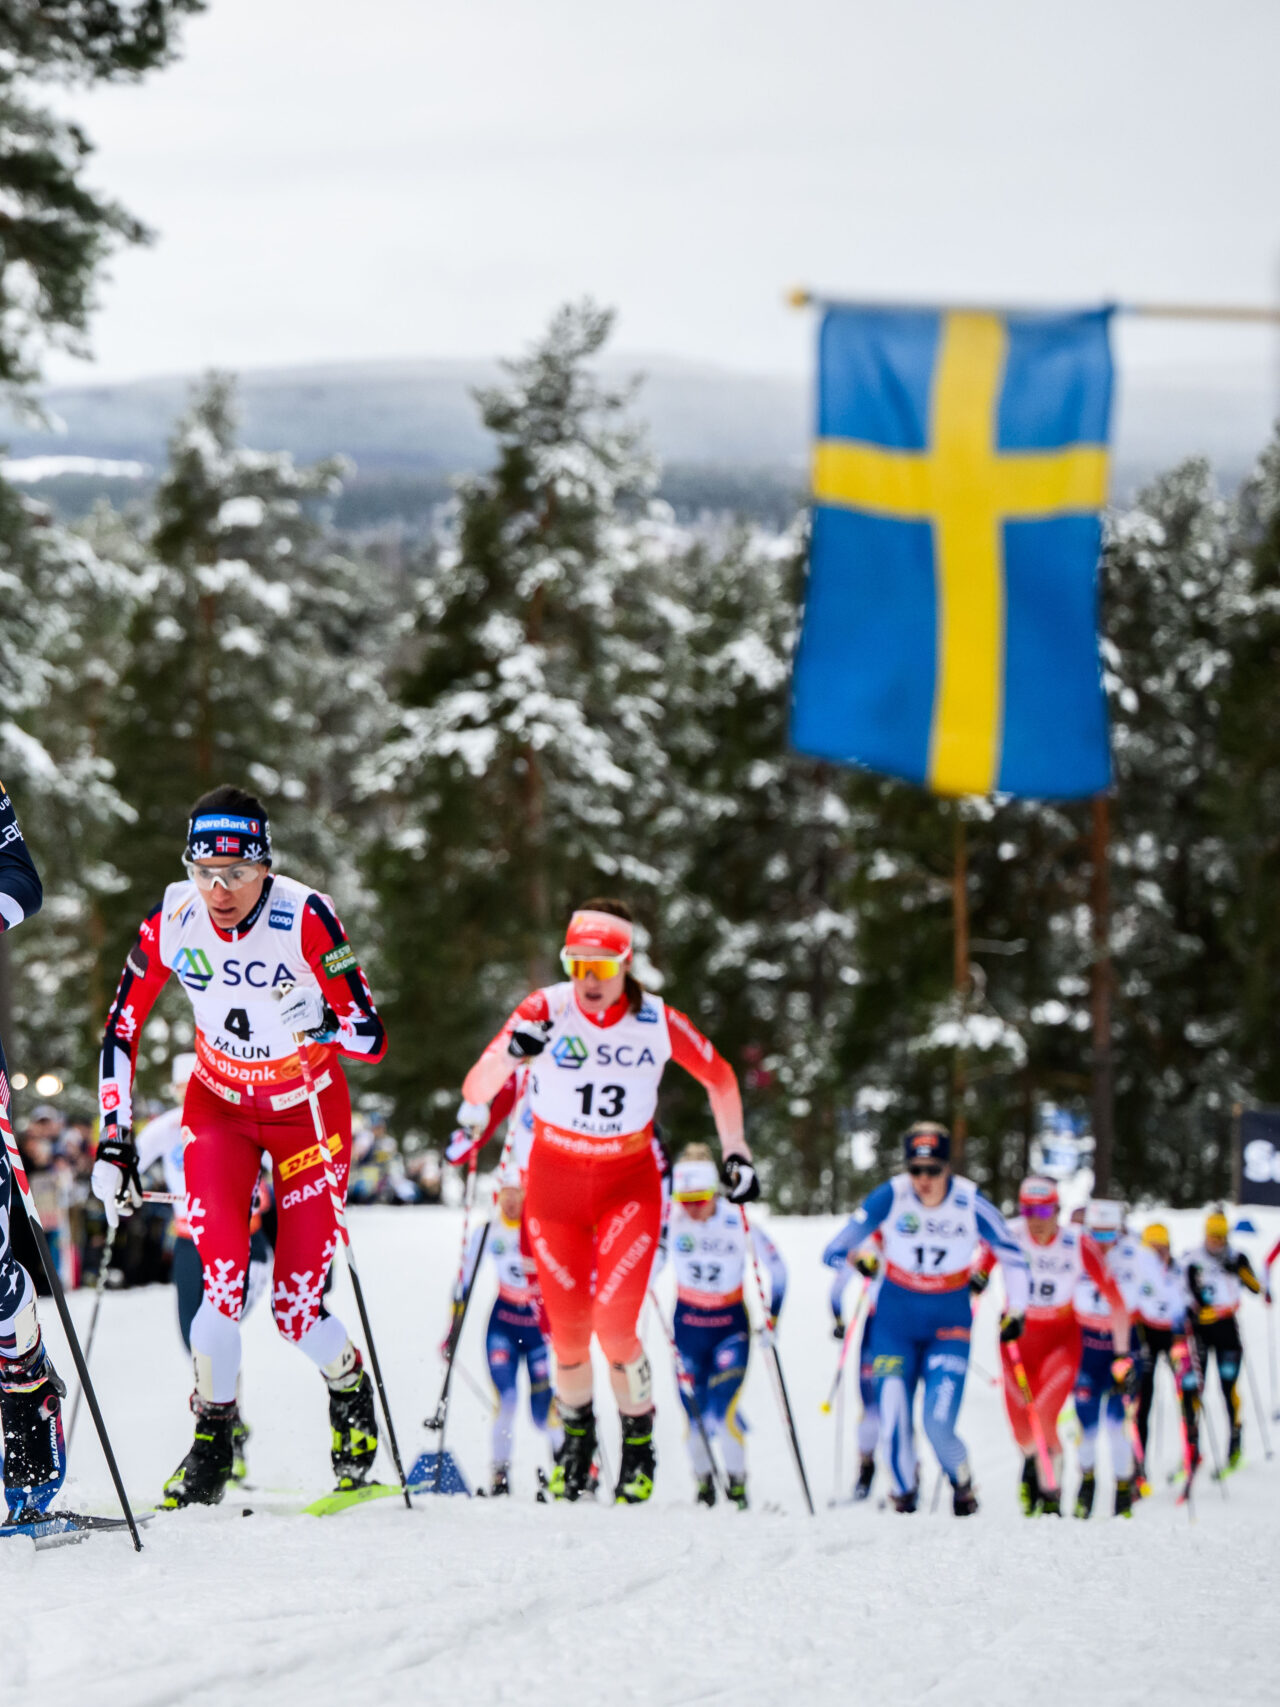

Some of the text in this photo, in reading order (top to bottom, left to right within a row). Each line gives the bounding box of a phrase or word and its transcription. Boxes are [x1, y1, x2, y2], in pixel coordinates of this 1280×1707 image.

[270, 914, 293, 927] coop
[222, 959, 296, 988] SCA
[224, 1007, 254, 1042] 4
[596, 1044, 656, 1067] SCA
[575, 1083, 627, 1118] 13
[572, 1119, 624, 1134] FALUN
[543, 1128, 624, 1155] Swedbank
[926, 1218, 968, 1238] SCA
[913, 1243, 947, 1267] 17
[49, 1416, 61, 1468] SALOMON
